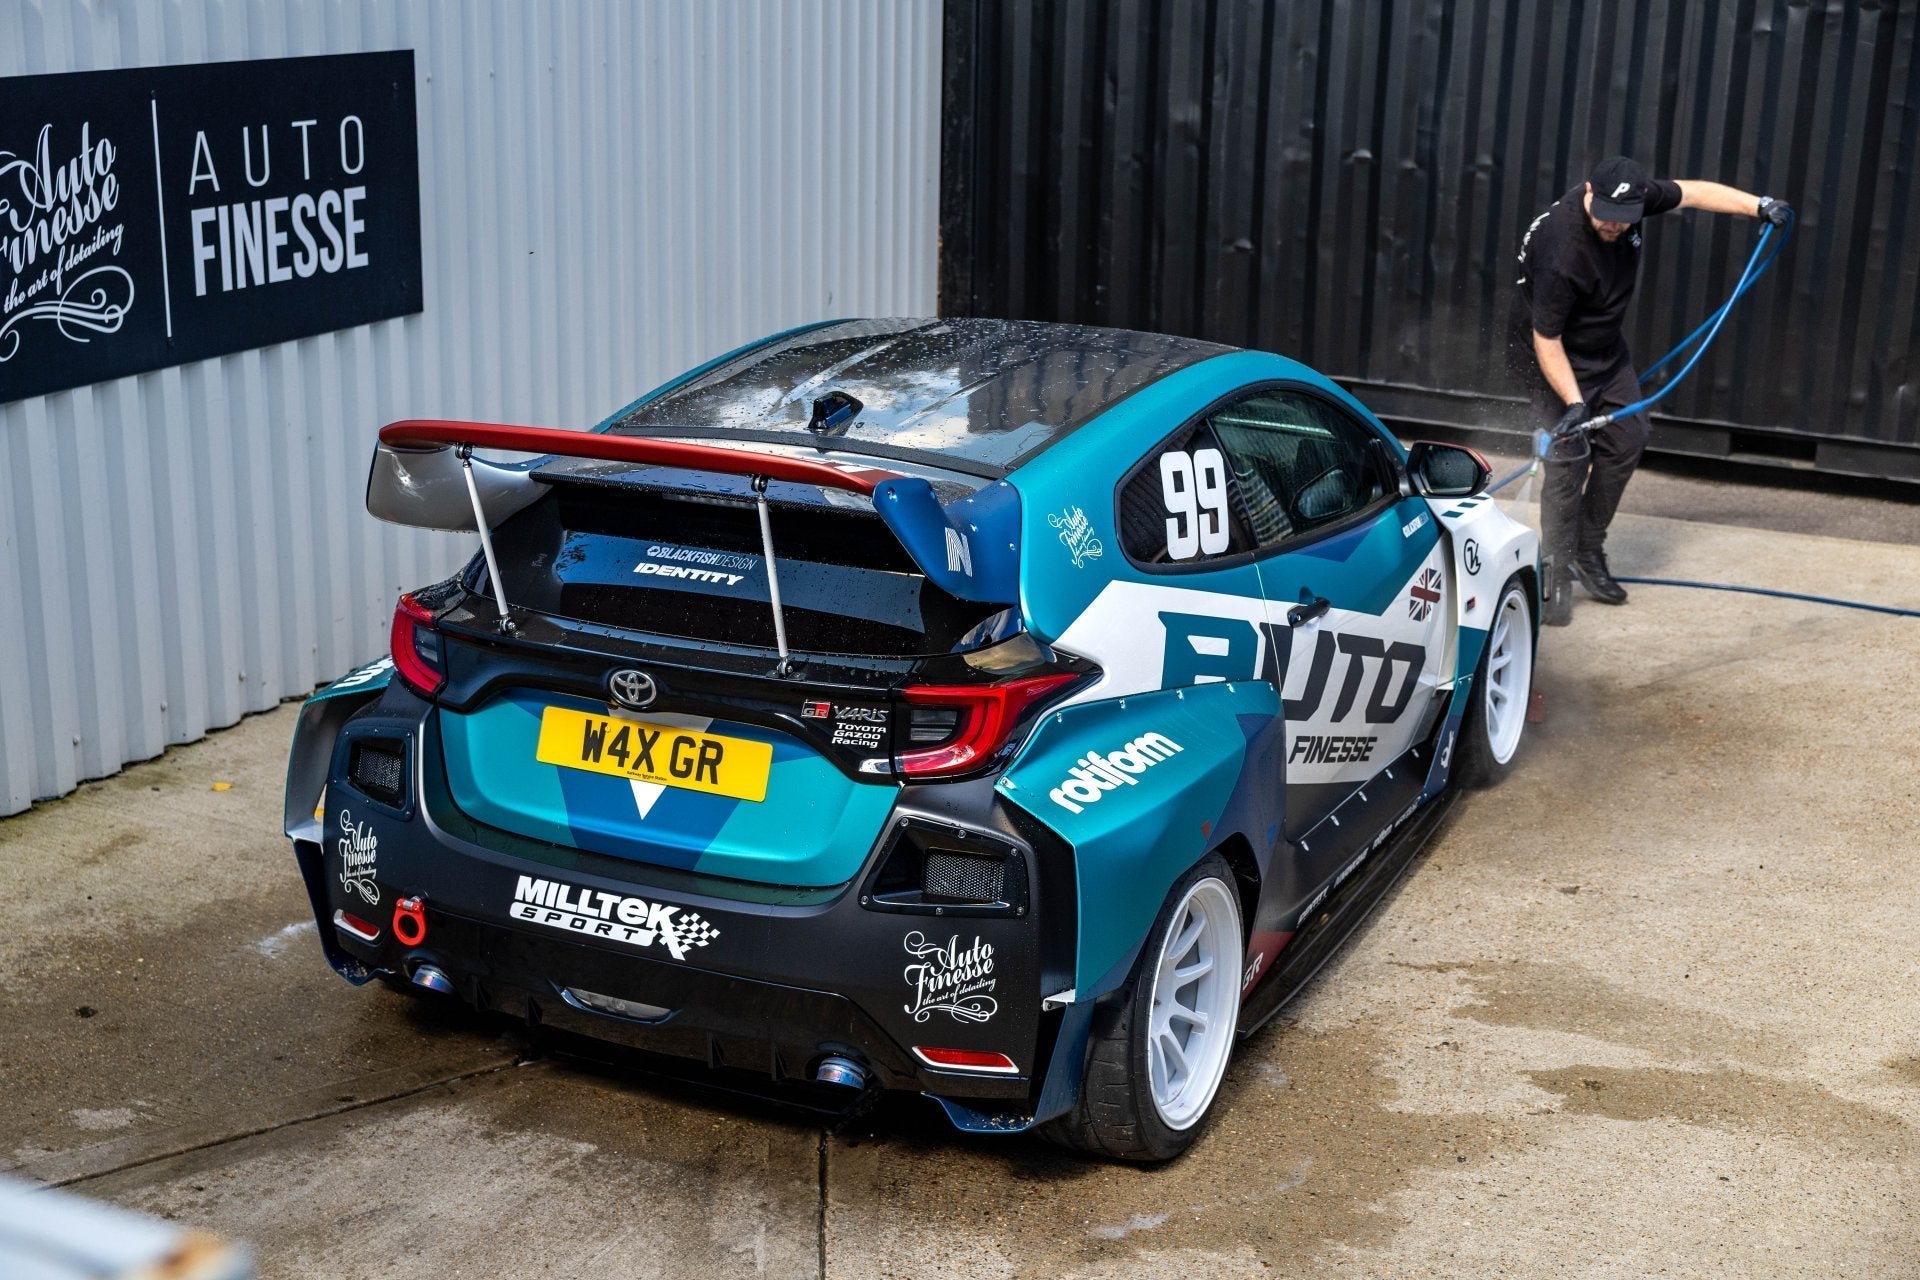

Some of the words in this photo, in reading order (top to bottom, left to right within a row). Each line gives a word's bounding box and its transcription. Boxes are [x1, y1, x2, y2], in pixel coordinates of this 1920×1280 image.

[189, 115, 365, 195] AUTO
[6, 121, 117, 232] Auto
[1611, 182, 1631, 198] P
[0, 173, 119, 274] inesse
[191, 185, 369, 297] FINESSE
[3, 277, 26, 313] the
[27, 269, 48, 296] art
[49, 245, 65, 295] of
[64, 223, 124, 256] detailing
[1159, 448, 1230, 560] 99
[633, 562, 744, 585] IDENTITY
[1157, 610, 1427, 724] AUTO
[802, 705, 829, 718] GR
[836, 722, 886, 733] TOYOTA
[581, 719, 661, 773] W4X
[669, 735, 724, 785] GR
[831, 737, 878, 748] Racing
[833, 729, 881, 740] GAZOO
[1288, 736, 1378, 765] FINESSE
[1049, 731, 1185, 815] rotiform
[345, 820, 378, 854] Auto
[339, 838, 377, 883] Finesse
[519, 906, 639, 941] SPORT
[912, 934, 995, 976] Auto
[1242, 952, 1264, 991] GR
[904, 958, 995, 1014] Finesse
[922, 992, 936, 1006] the
[959, 978, 996, 991] detailing
